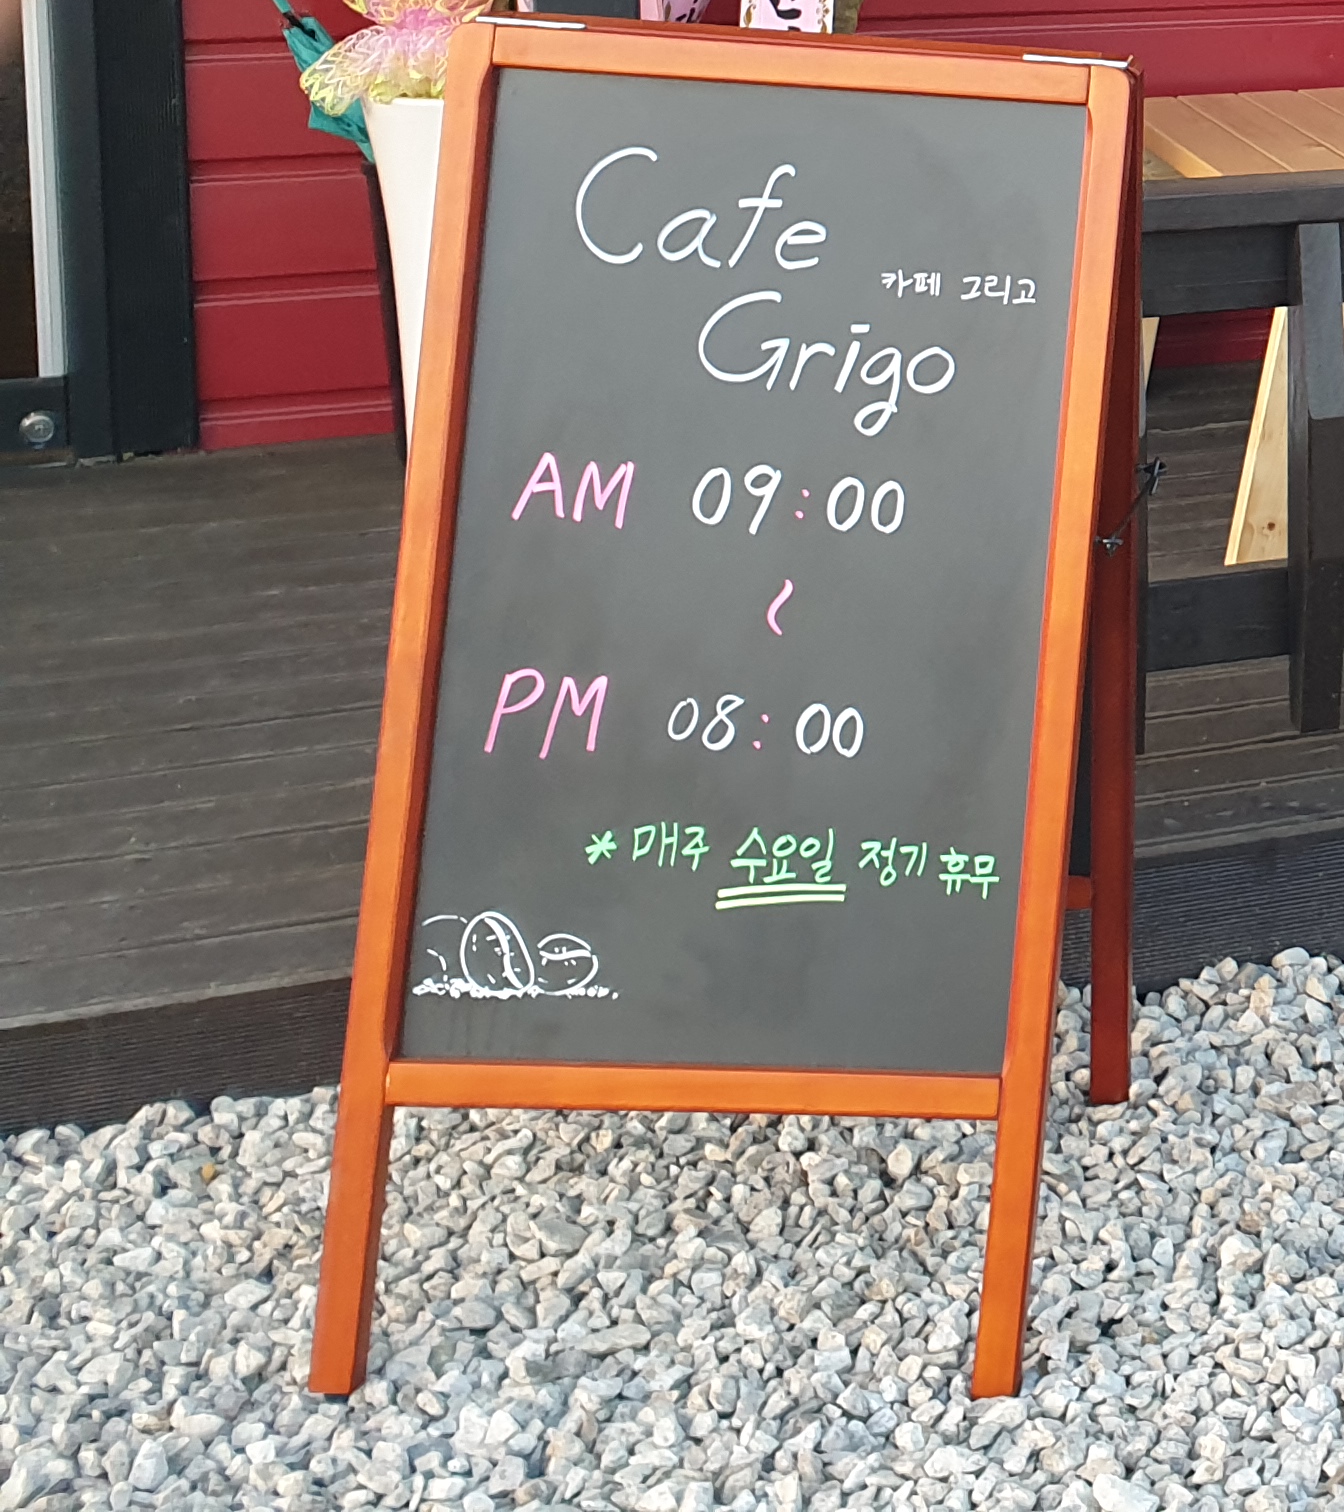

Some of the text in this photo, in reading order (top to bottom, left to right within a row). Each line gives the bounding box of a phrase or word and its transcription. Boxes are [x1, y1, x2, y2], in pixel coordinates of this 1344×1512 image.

[574, 146, 828, 270] Cafe
[880, 269, 1037, 306] 카페 그리고
[697, 290, 956, 437] Grigo
[511, 451, 905, 535] AM 09:00
[483, 667, 864, 760] PM 08:00
[632, 821, 1000, 900] 매주 수요일 정기 휴무
